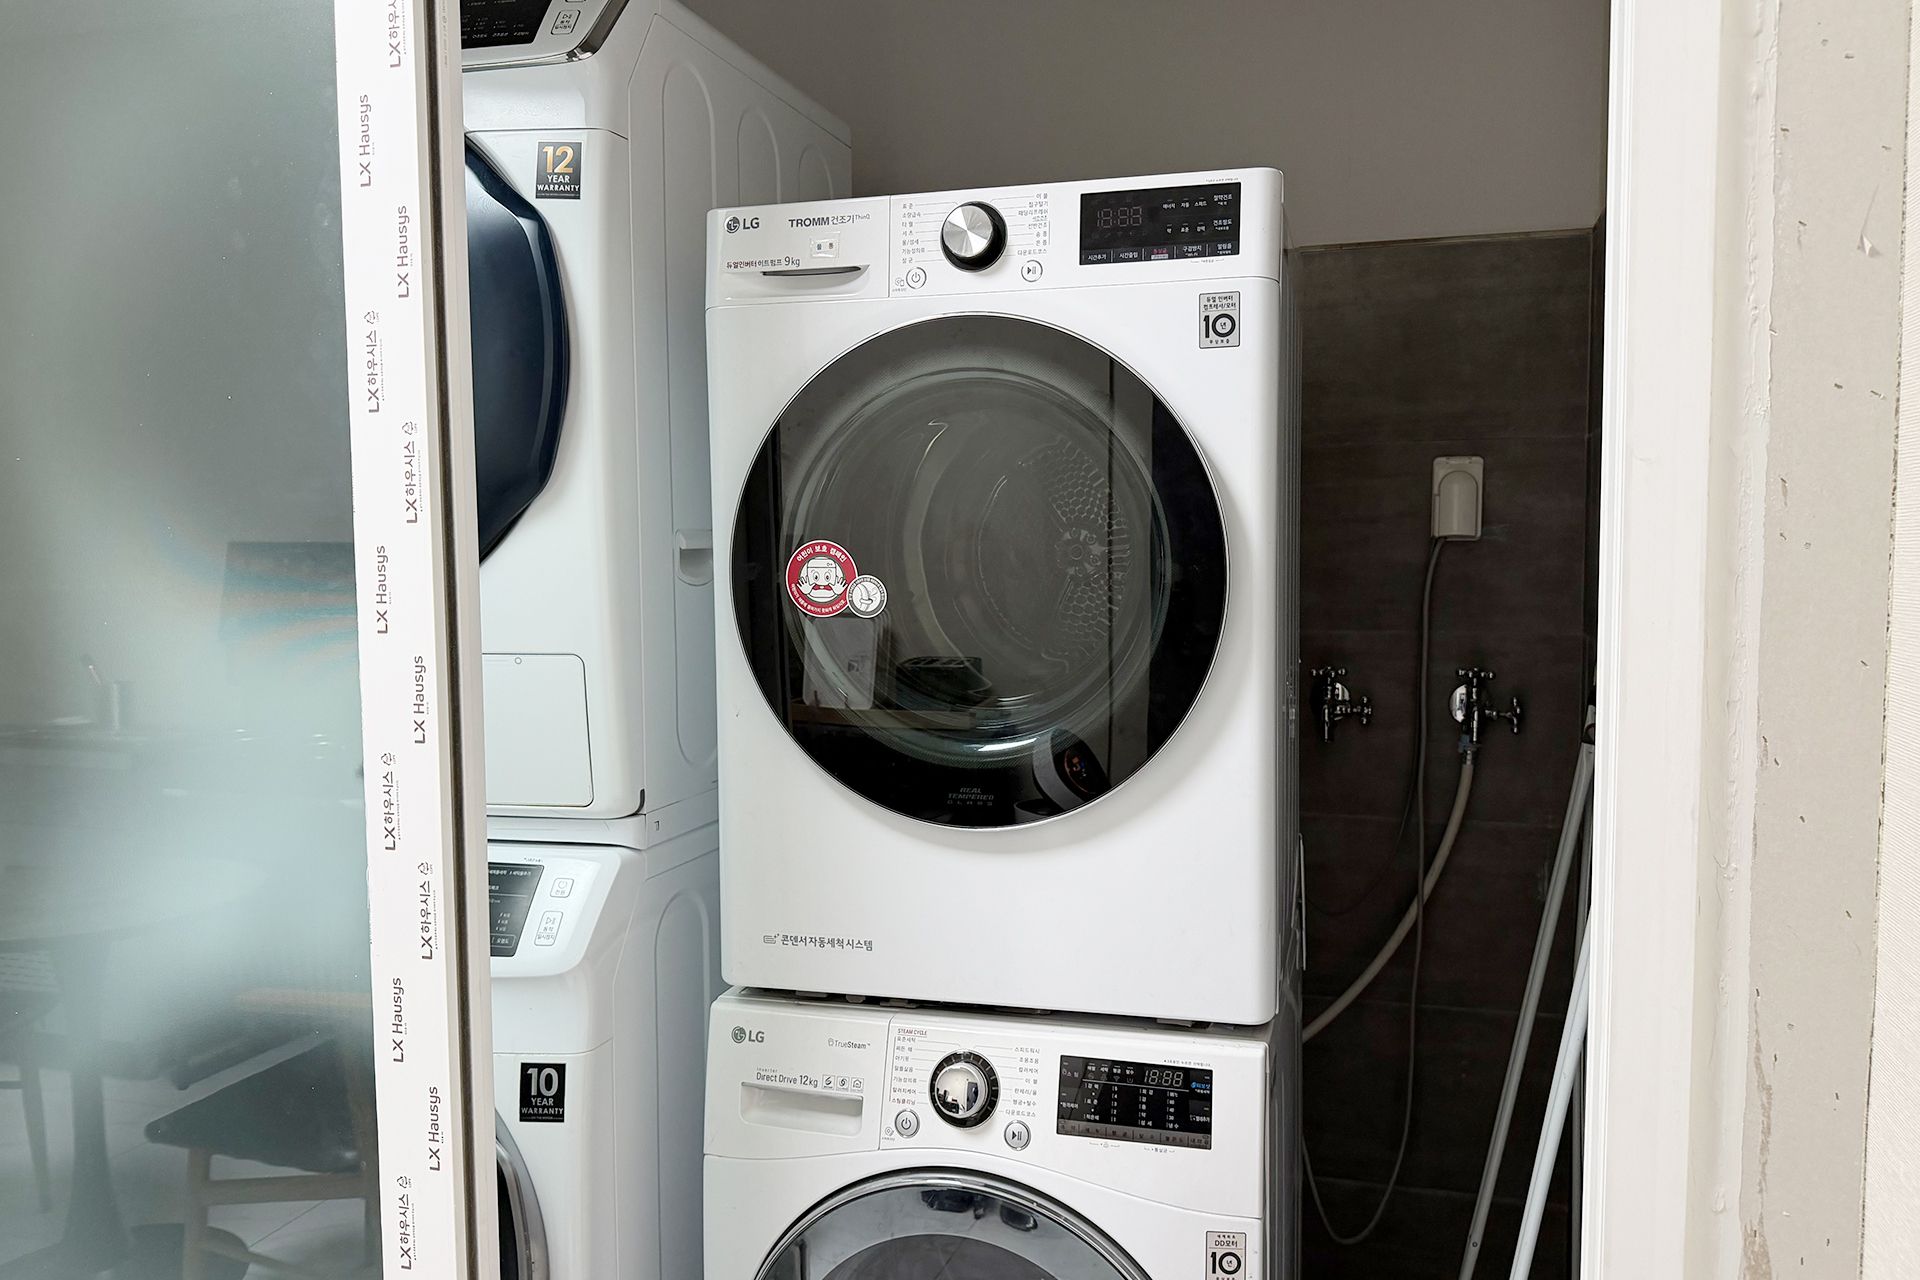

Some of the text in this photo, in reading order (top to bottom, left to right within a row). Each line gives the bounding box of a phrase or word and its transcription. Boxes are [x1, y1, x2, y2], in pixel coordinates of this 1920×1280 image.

[359, 94, 372, 187] LX Hausys
[543, 145, 574, 173] 12
[537, 184, 580, 192] WARRANTY
[547, 174, 570, 183] YEAR
[743, 217, 760, 230] LG
[789, 218, 830, 228] TROMM
[831, 215, 855, 225] 건조기
[397, 205, 410, 299] LX Hausys
[784, 256, 800, 267] 9kg
[1203, 314, 1236, 339] 10
[366, 330, 380, 413] LX하우시스
[404, 441, 418, 524] LX하우시스
[796, 547, 814, 562] 어린이
[815, 545, 828, 553] 보호
[376, 545, 389, 635] LX Hausys
[413, 655, 426, 744] LX Hausys
[382, 771, 396, 851] LX하우시스
[419, 881, 433, 960] LX하우시스
[781, 935, 873, 952] 콘덴서 자동세척 시스템
[391, 977, 405, 1063] LX Hausys
[748, 1031, 765, 1043] LG
[527, 1067, 559, 1097] 10
[756, 1072, 818, 1088] Direct Drive 12kg
[1144, 1069, 1184, 1087] 18:88
[521, 1107, 564, 1115] WARRANTY
[531, 1097, 554, 1106] YEAR
[428, 1086, 441, 1172] LX Hausys
[398, 1194, 412, 1270] LX하우시스
[1215, 1240, 1238, 1248] DD모터
[1210, 1252, 1242, 1275] 10
